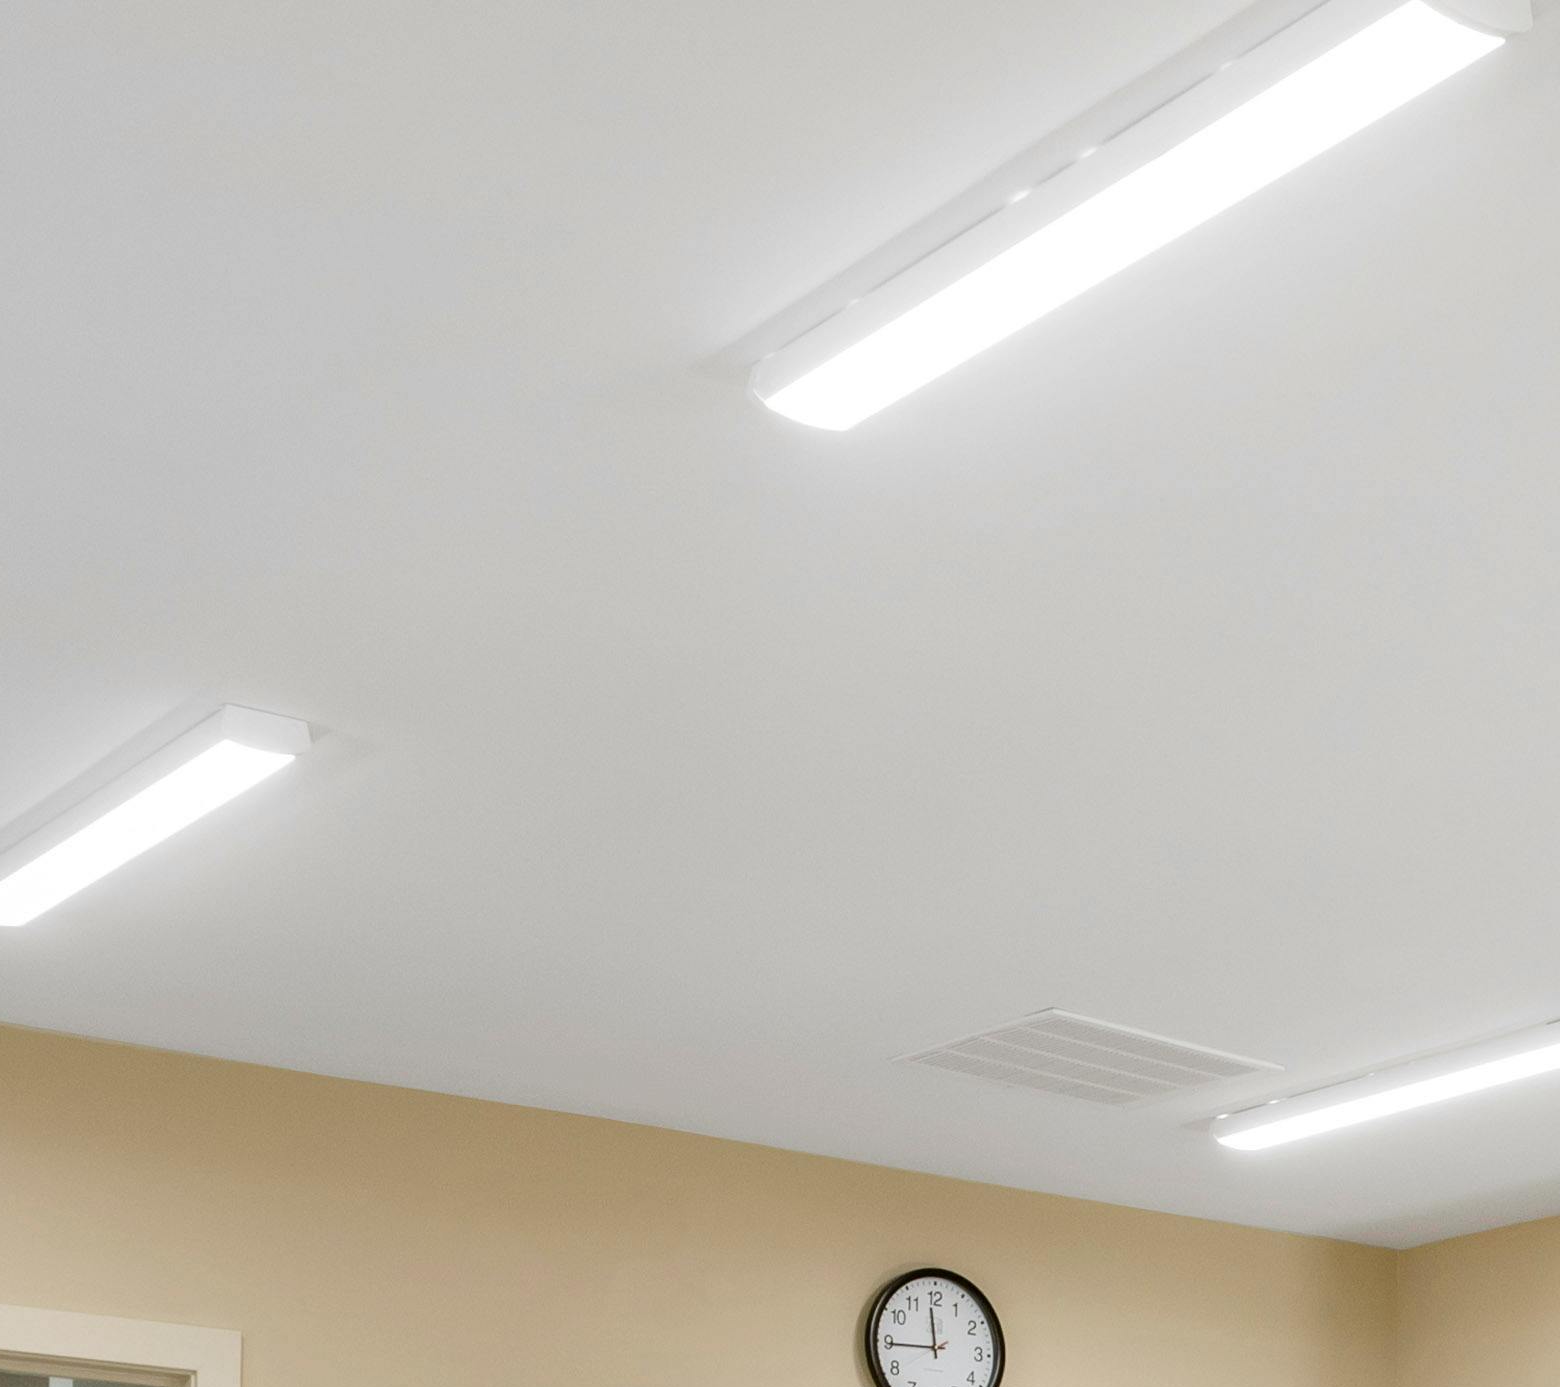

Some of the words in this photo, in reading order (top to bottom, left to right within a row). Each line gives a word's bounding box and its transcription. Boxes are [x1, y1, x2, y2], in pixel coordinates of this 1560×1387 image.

[906, 1296, 919, 1312] 11
[928, 1291, 943, 1307] 12
[891, 1309, 906, 1325] 10
[953, 1303, 959, 1317] 1
[967, 1320, 977, 1336] 2
[884, 1334, 893, 1350] 9
[974, 1347, 983, 1362] 3
[890, 1360, 900, 1376] 8
[967, 1371, 975, 1386] 4
